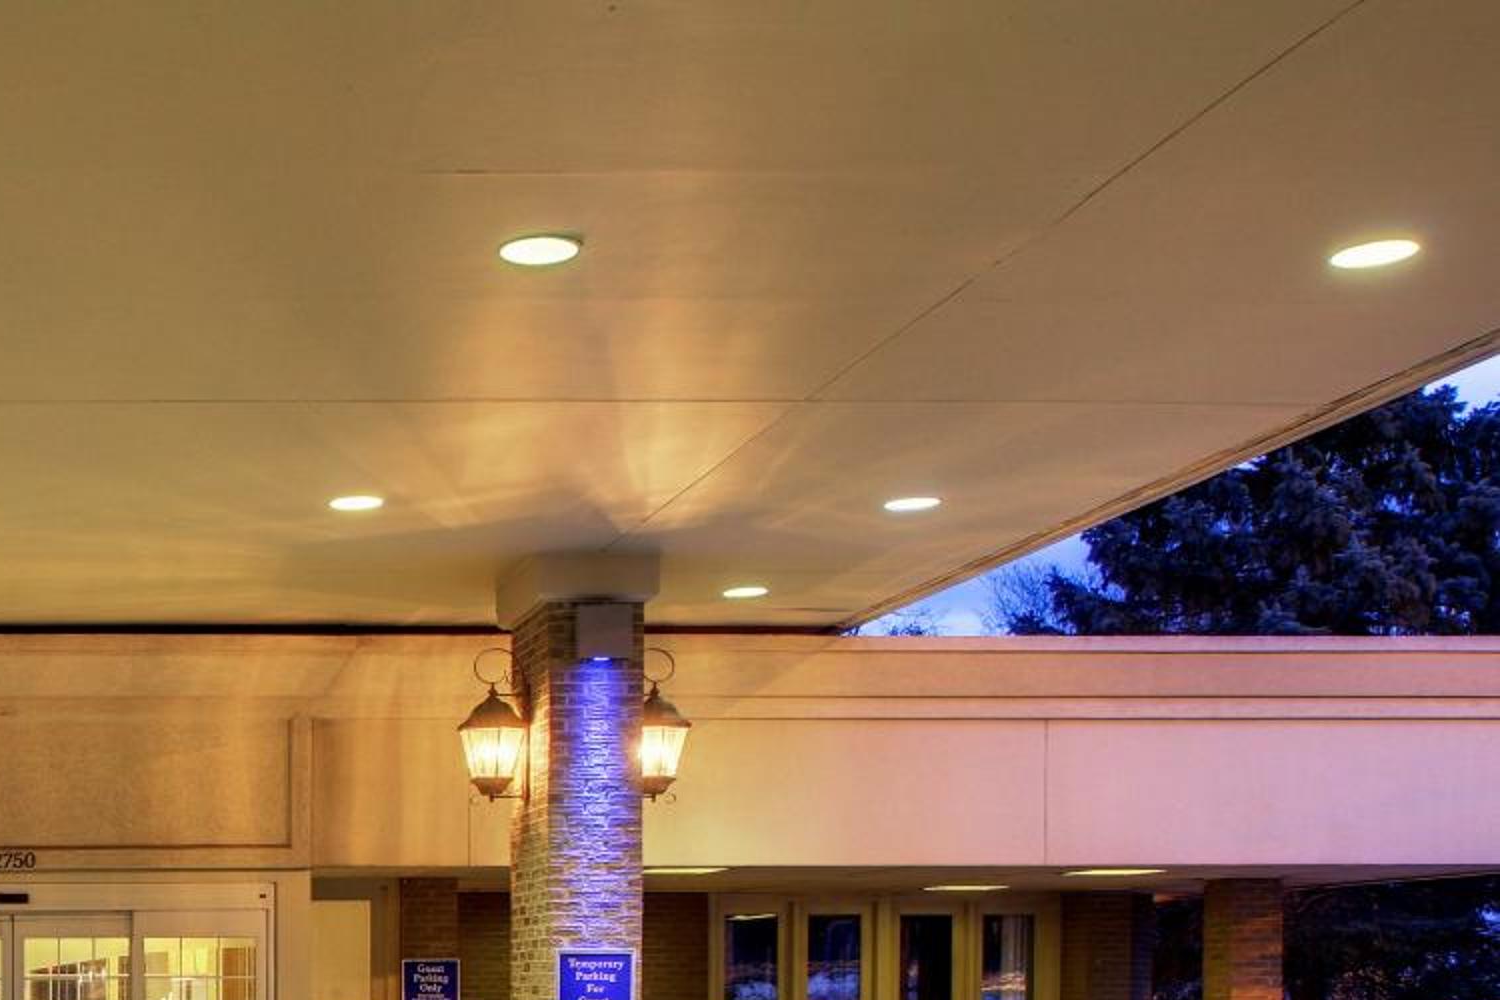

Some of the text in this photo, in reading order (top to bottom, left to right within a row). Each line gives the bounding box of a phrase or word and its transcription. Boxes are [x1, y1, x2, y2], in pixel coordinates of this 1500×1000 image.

[567, 957, 625, 971] Temporary
[575, 971, 617, 983] Parking
[586, 983, 605, 993] For
